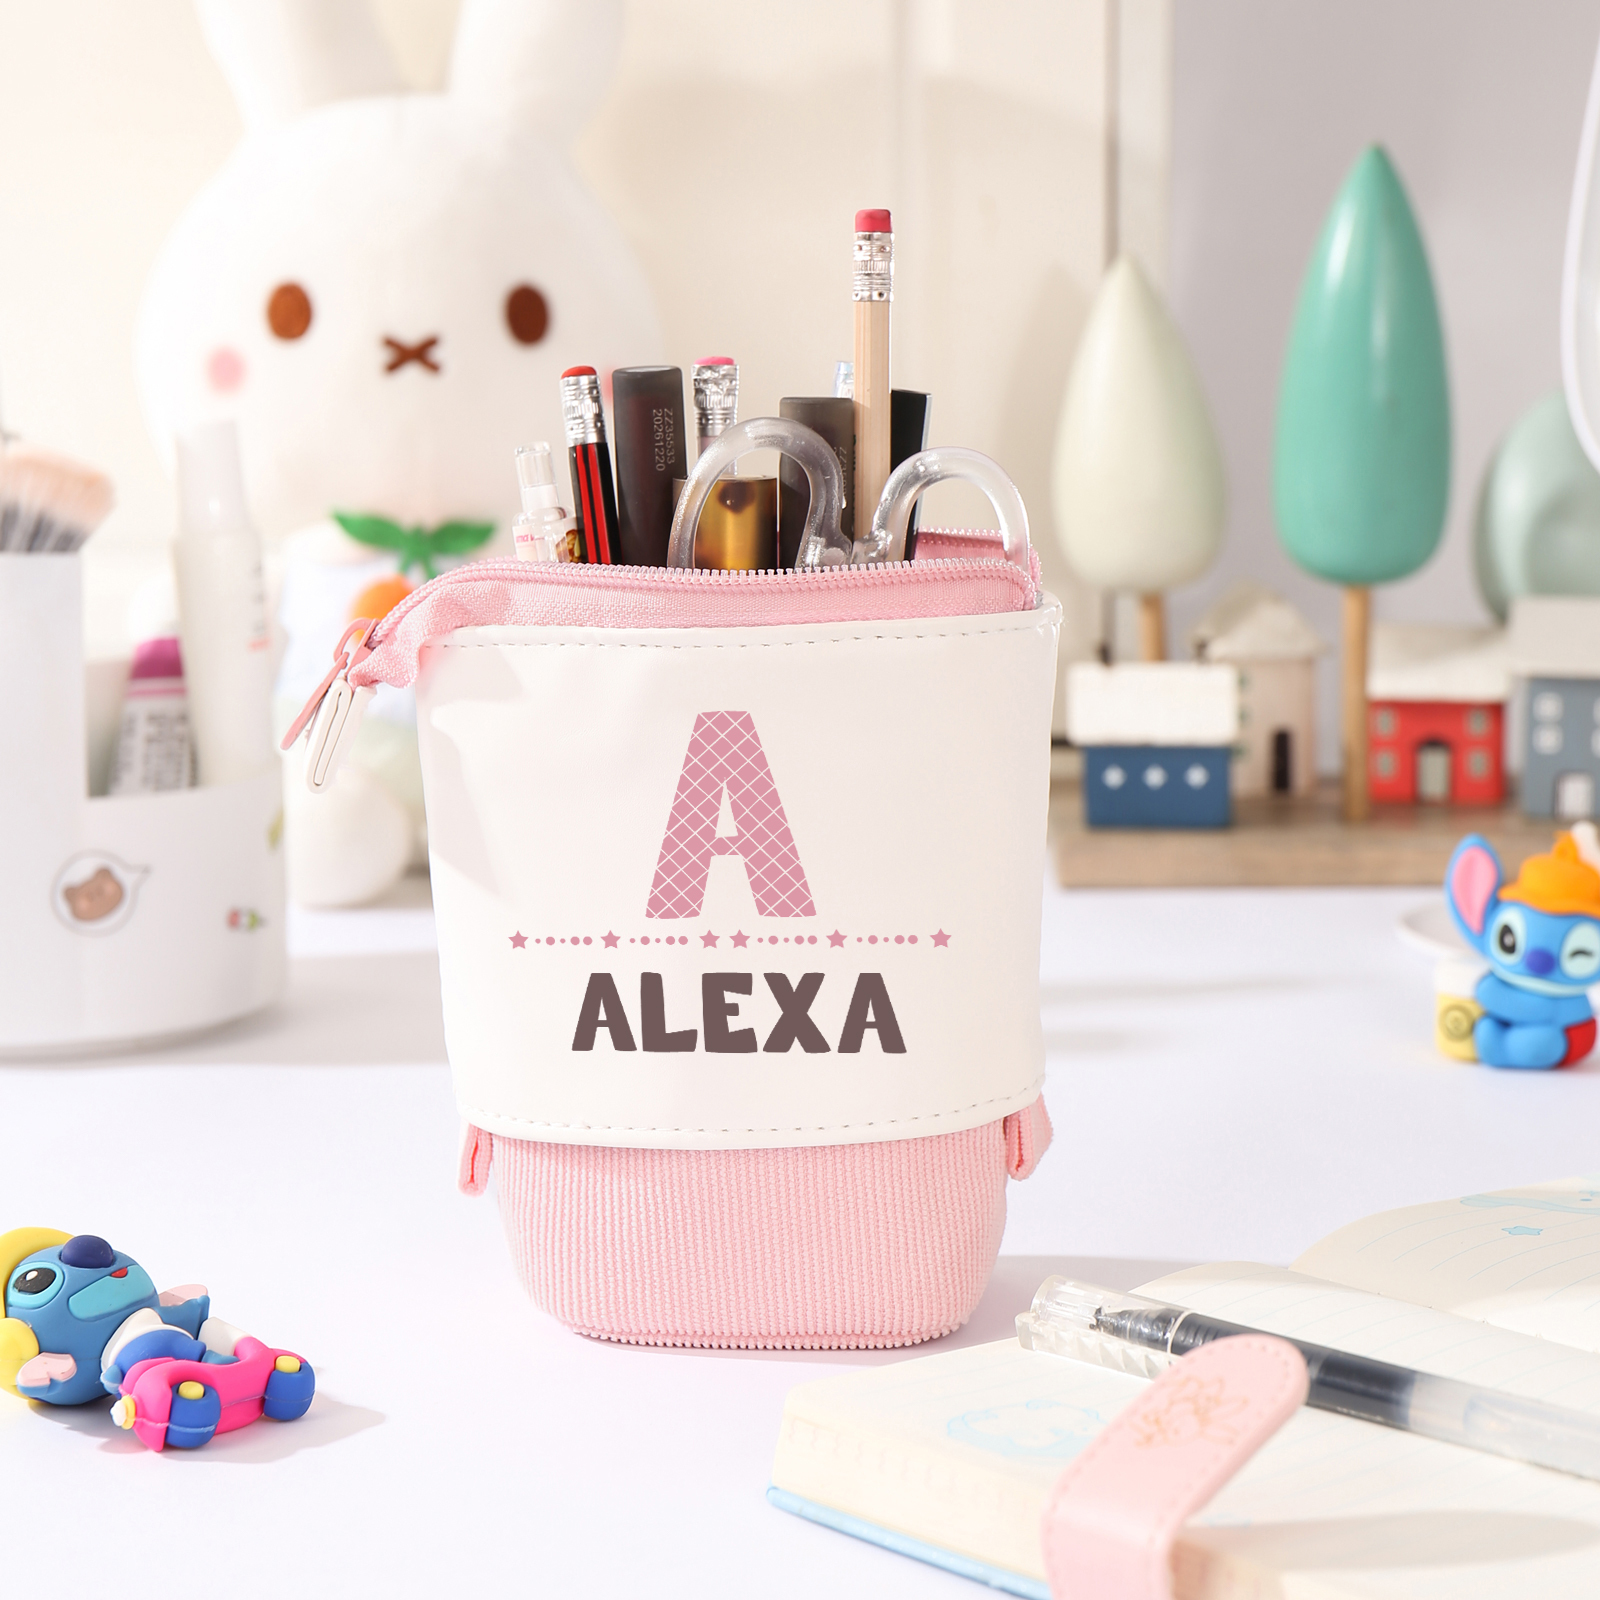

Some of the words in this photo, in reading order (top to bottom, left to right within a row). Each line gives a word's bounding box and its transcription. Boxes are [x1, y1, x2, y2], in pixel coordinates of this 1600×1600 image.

[652, 408, 666, 471] 20261220
[664, 408, 675, 464] ZZ35533
[645, 710, 817, 919] A
[572, 972, 907, 1054] ALEXA
